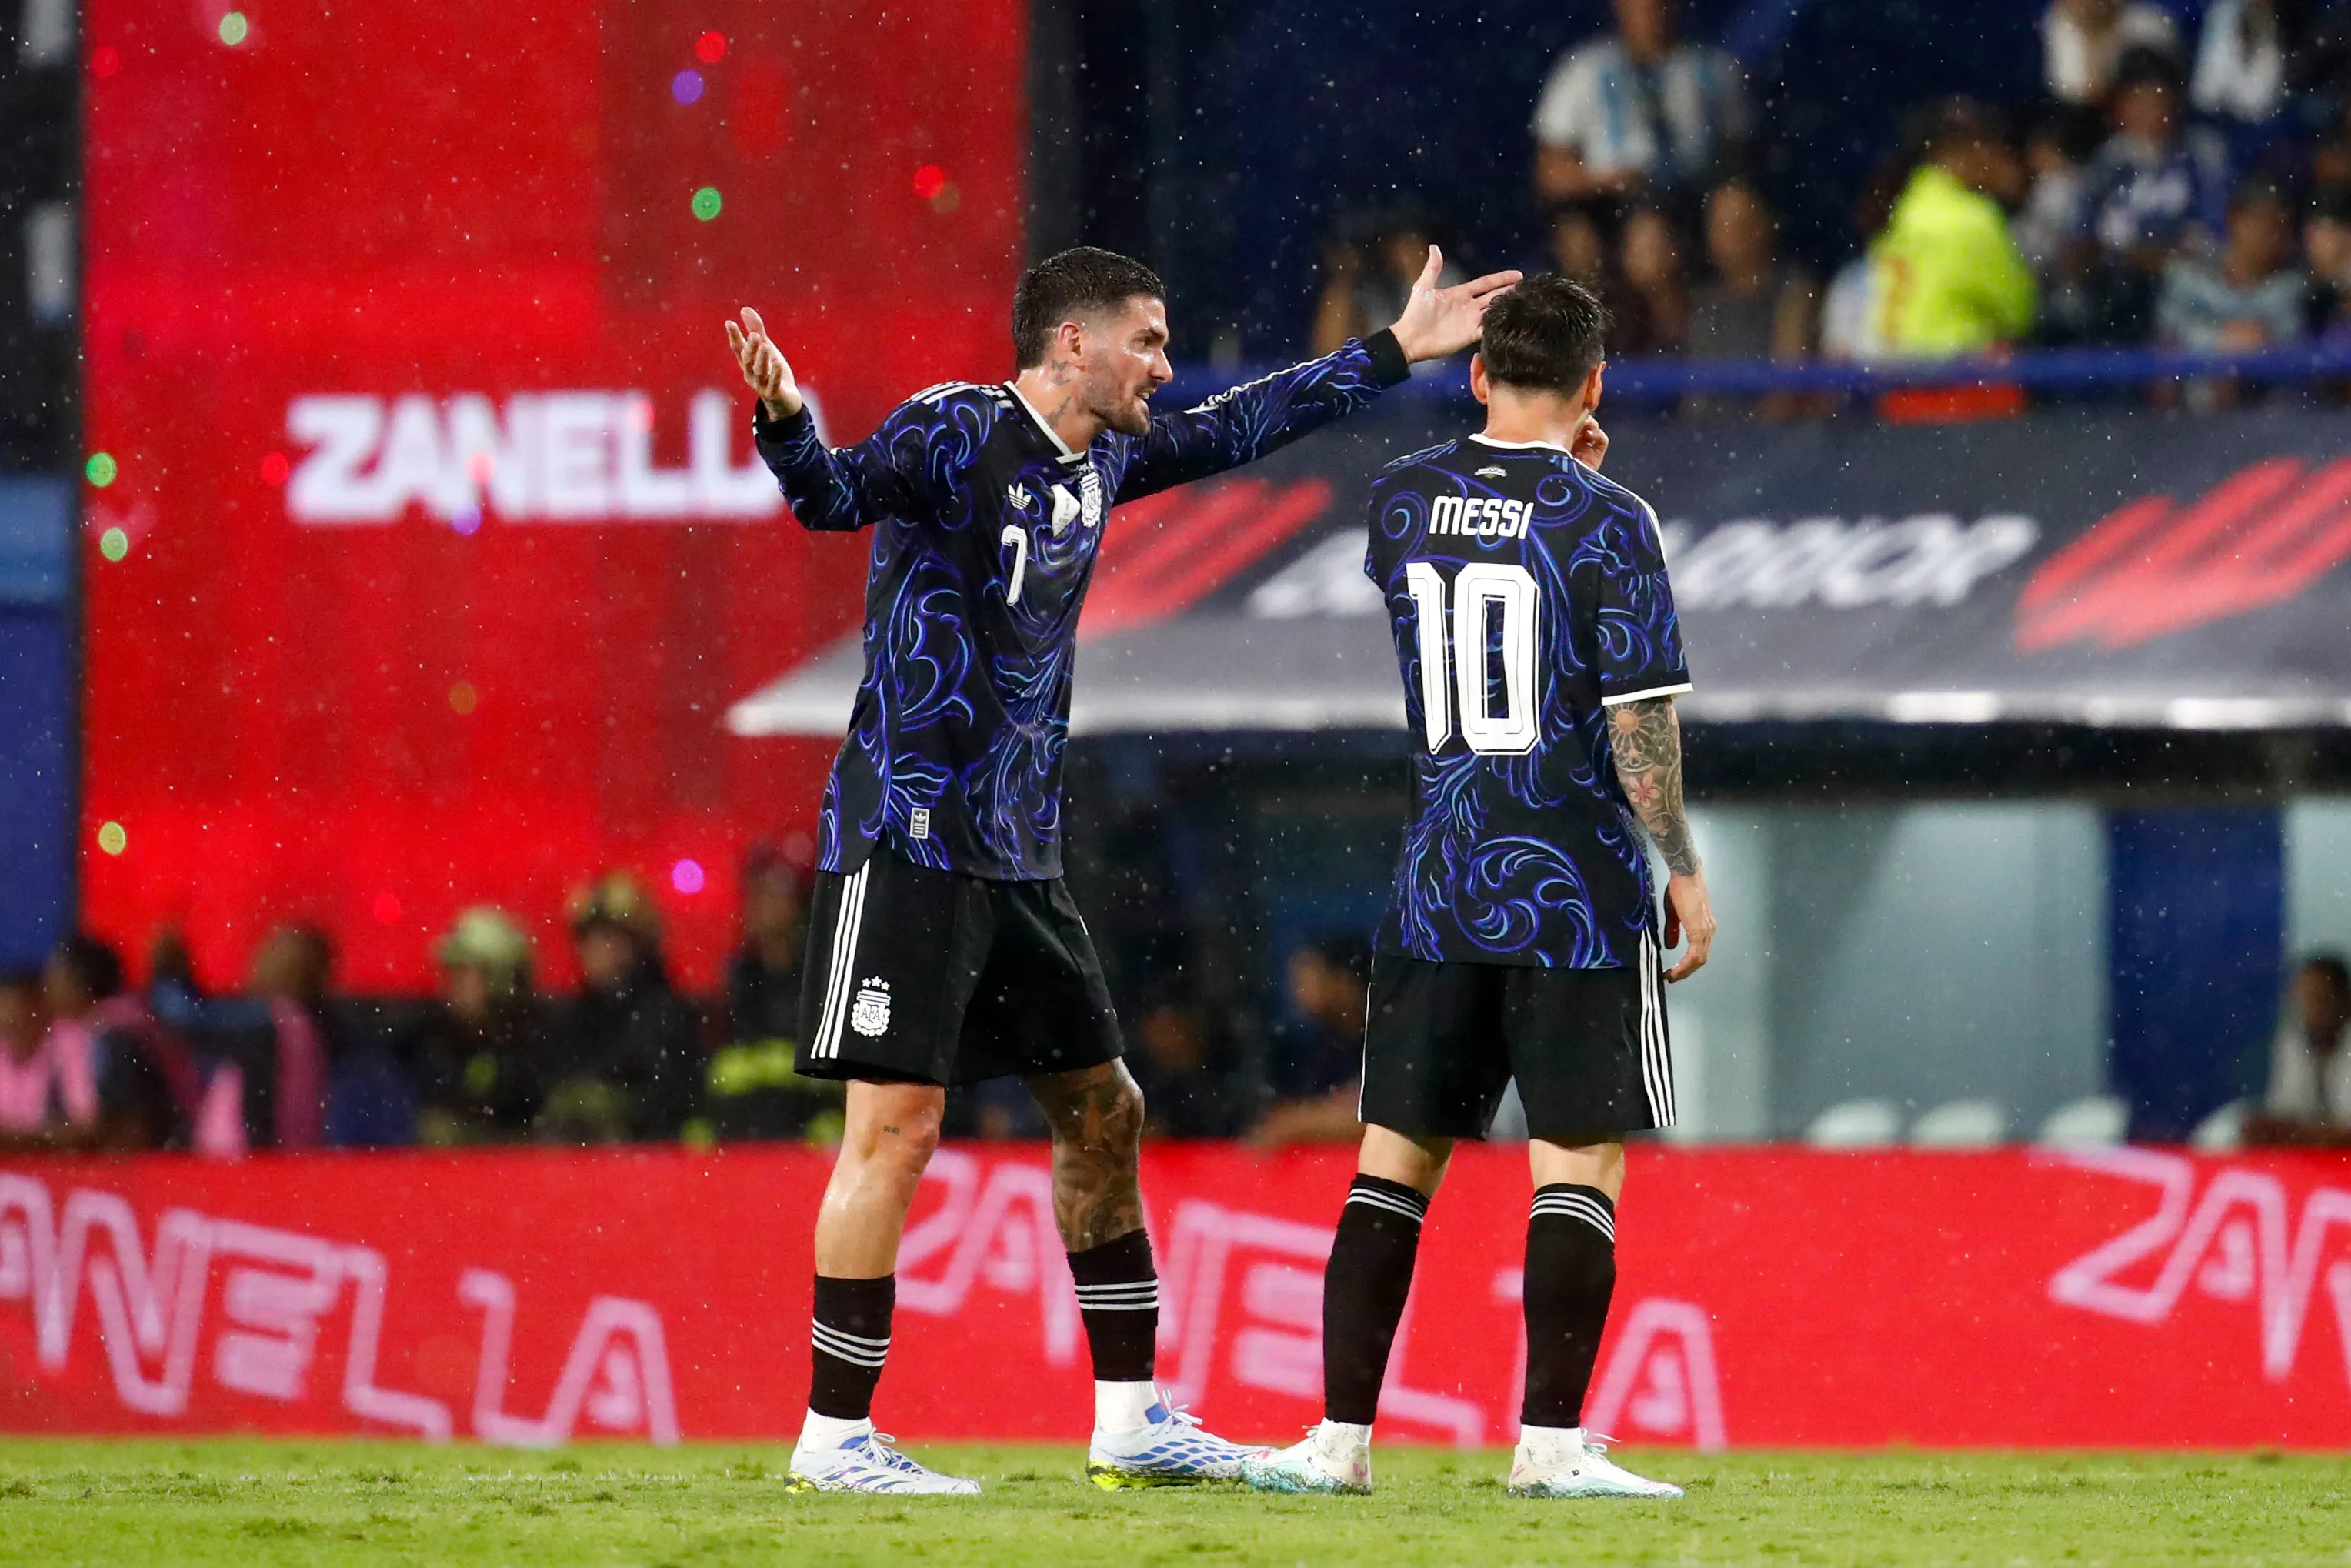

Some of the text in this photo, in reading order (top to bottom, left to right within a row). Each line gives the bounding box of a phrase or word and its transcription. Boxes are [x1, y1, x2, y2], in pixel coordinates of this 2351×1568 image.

[287, 391, 829, 522] ZANELL
[1429, 495, 1535, 540] MESSI
[1001, 523, 1028, 606] 7
[1406, 562, 1542, 756] 10
[860, 1003, 881, 1023] AFA
